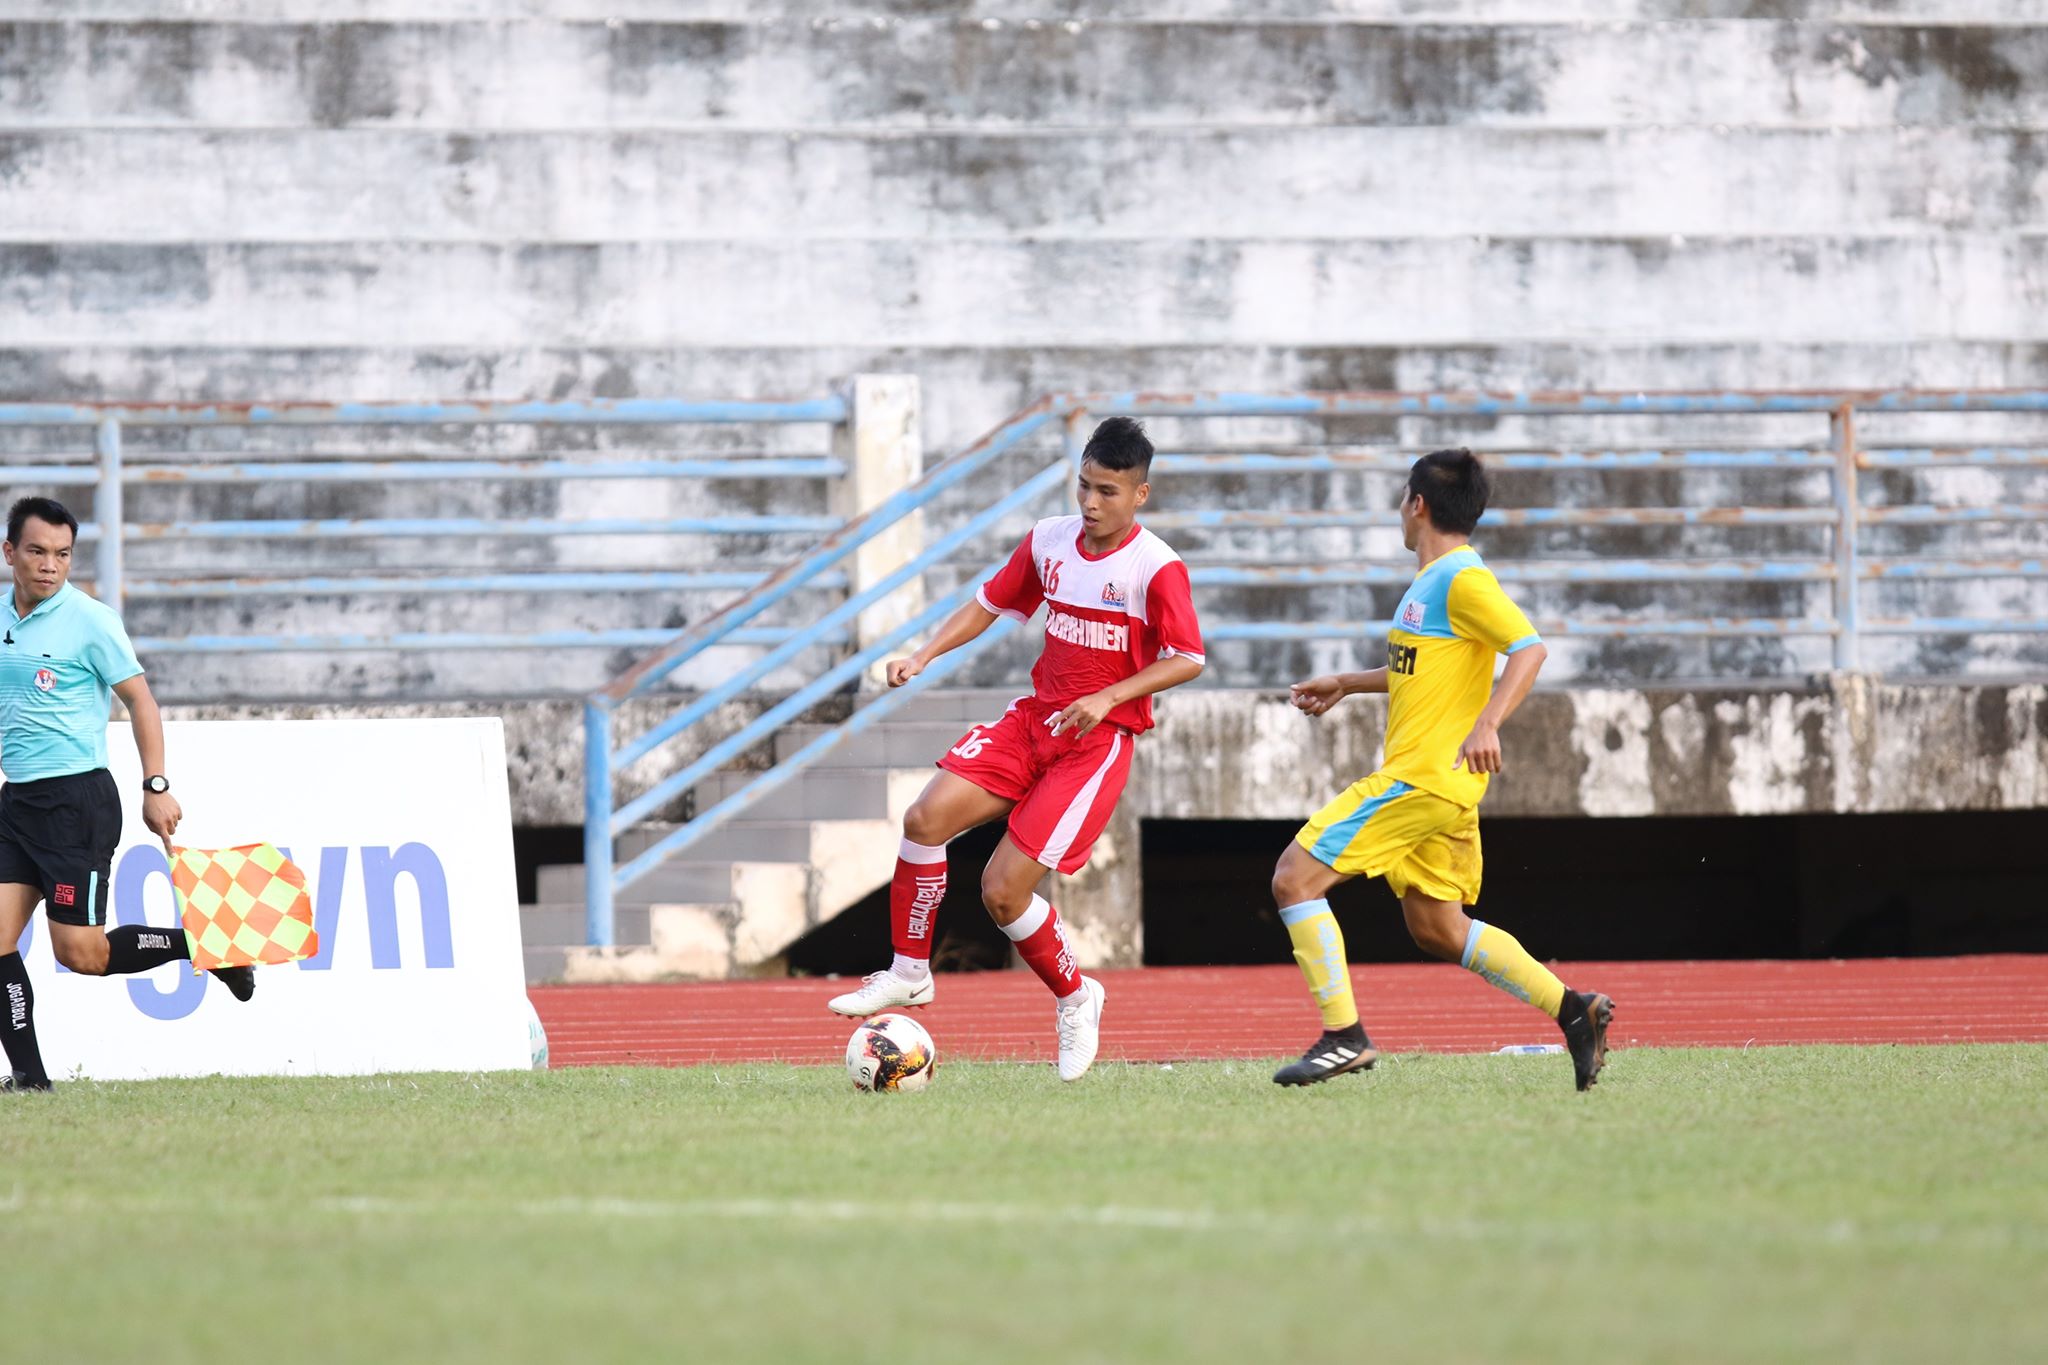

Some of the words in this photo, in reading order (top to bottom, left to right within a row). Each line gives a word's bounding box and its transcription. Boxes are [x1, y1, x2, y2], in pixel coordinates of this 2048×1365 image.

[1043, 556, 1064, 596] 16
[951, 729, 993, 759] 16
[6, 982, 27, 1031] JOGARBOLA
